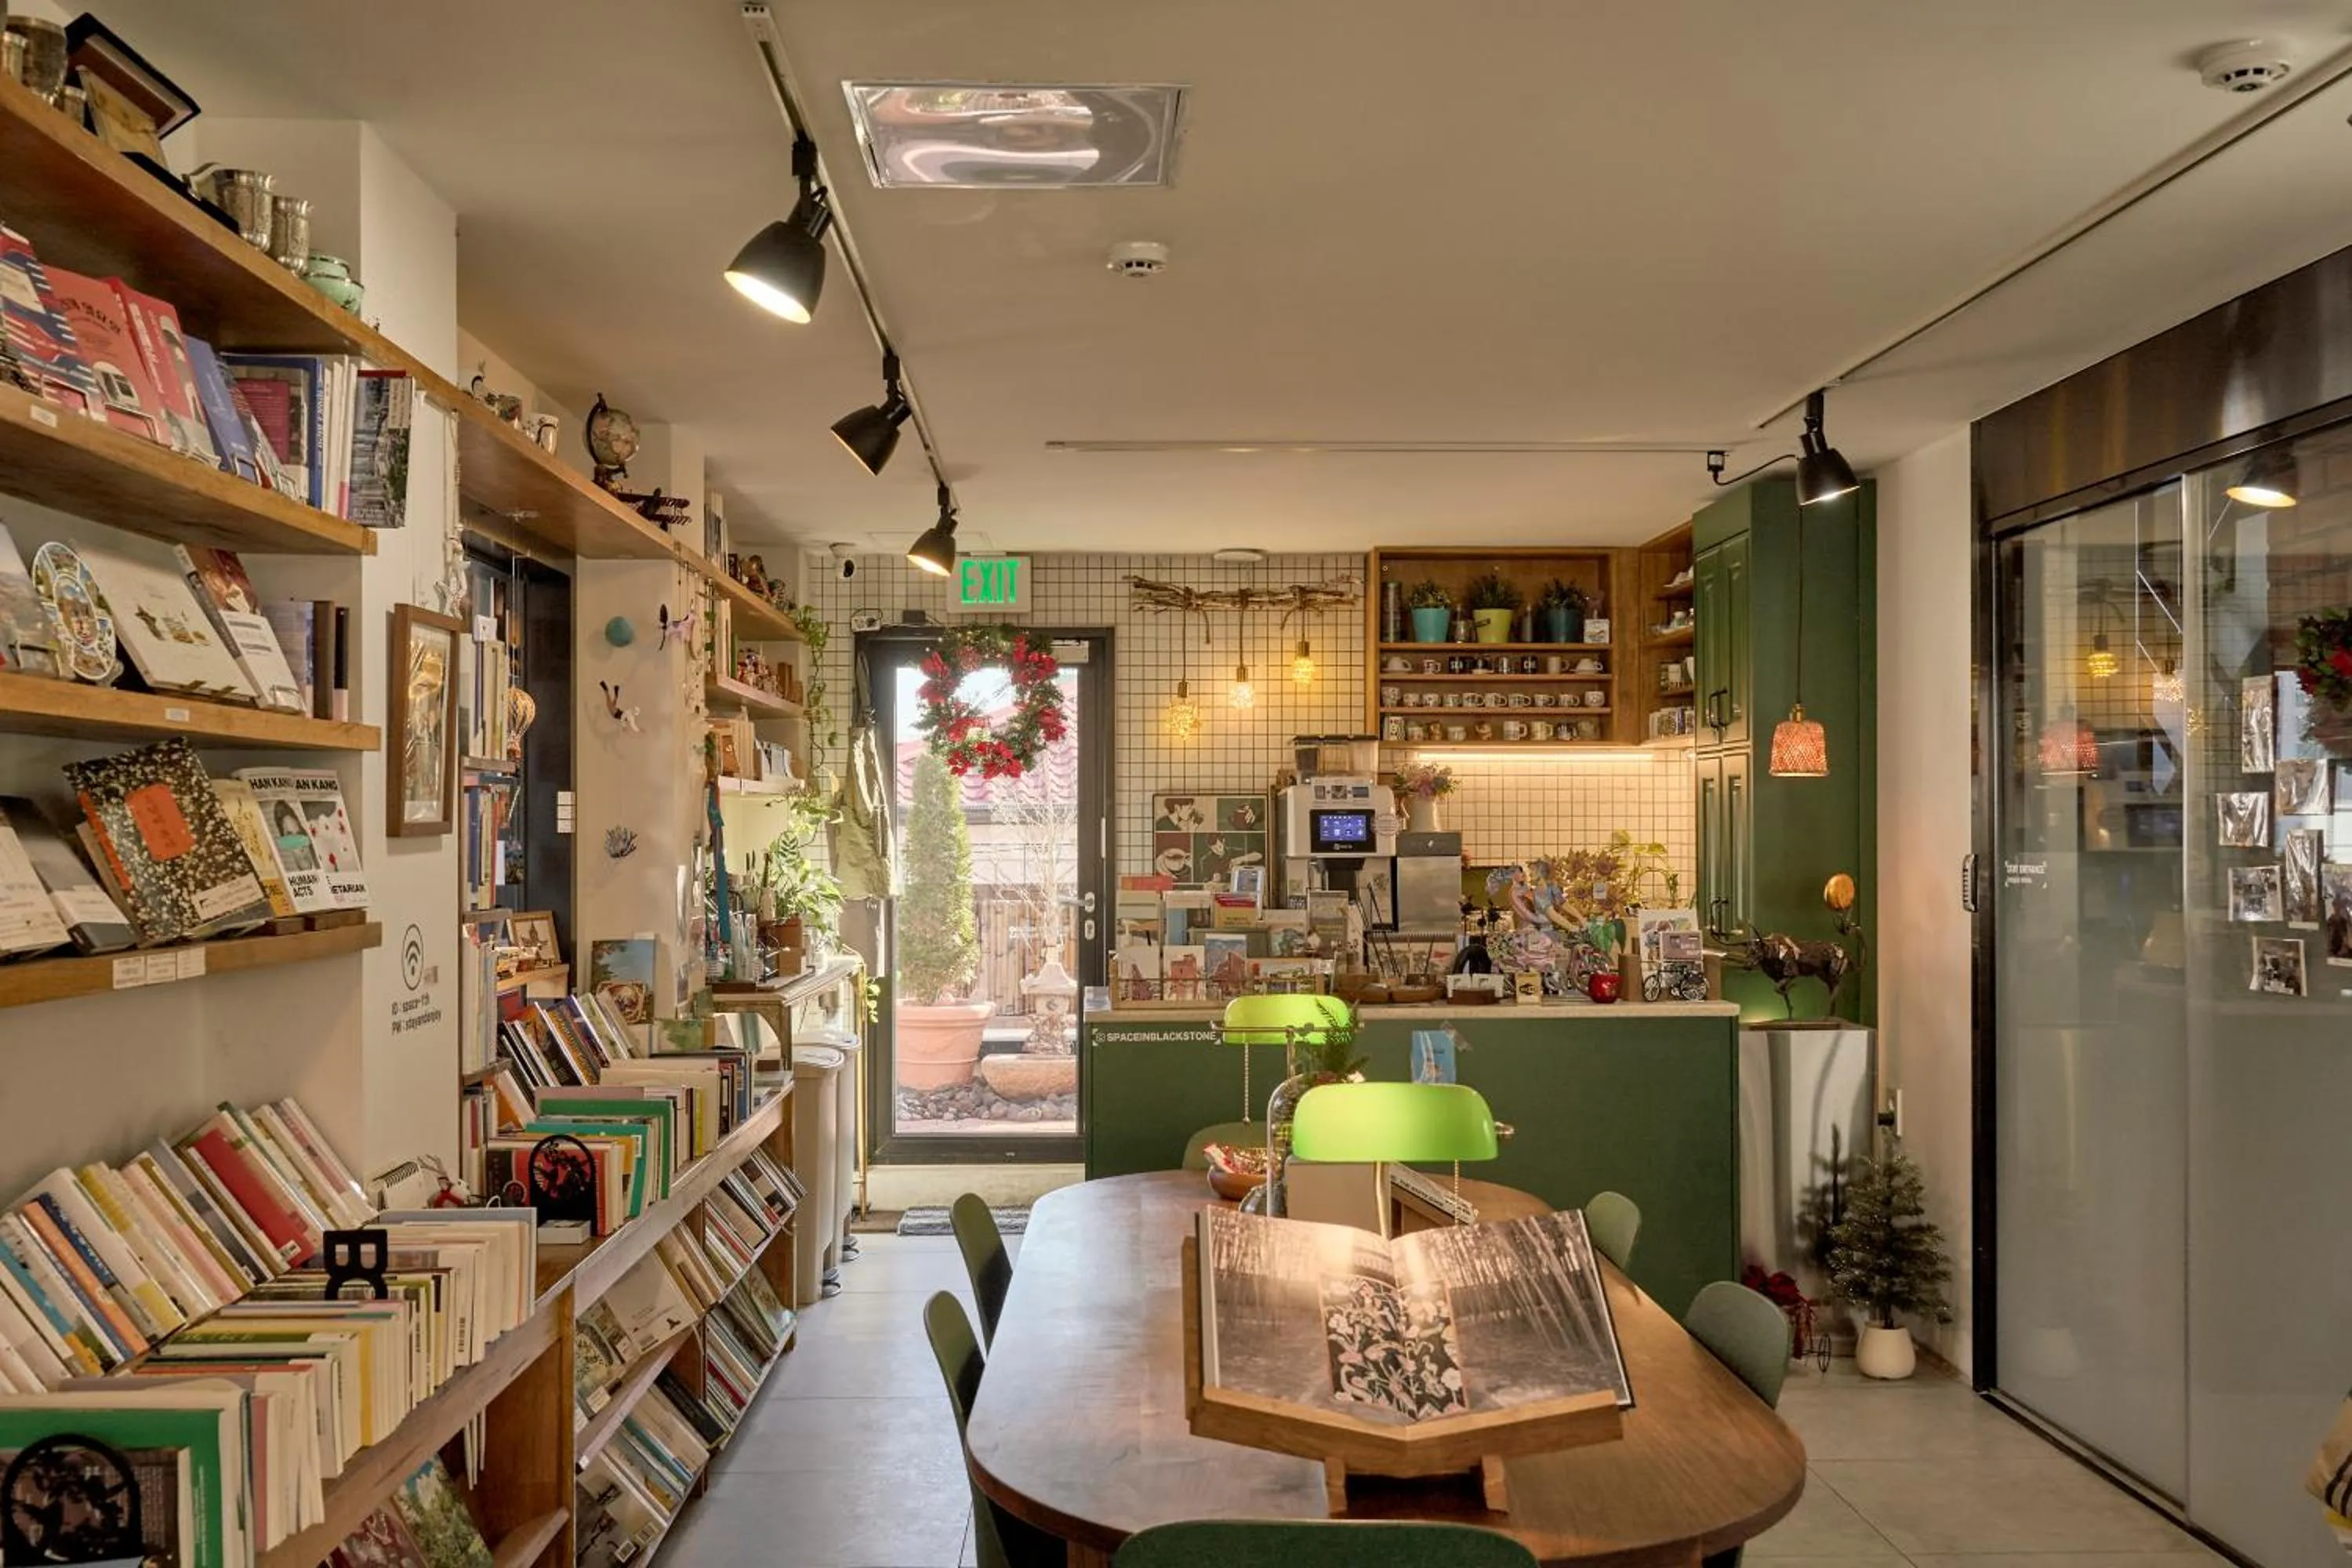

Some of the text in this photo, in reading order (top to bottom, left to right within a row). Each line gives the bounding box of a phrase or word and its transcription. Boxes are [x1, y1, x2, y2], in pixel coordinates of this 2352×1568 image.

[961, 560, 1019, 603] EXIT
[249, 777, 271, 790] HAN
[295, 779, 339, 791] AN KANG
[288, 873, 318, 886] HUMAN
[292, 885, 314, 898] ACTS
[329, 883, 367, 895] ETARIAN
[1106, 1031, 1216, 1042] SPACEINBLACKSTONE
